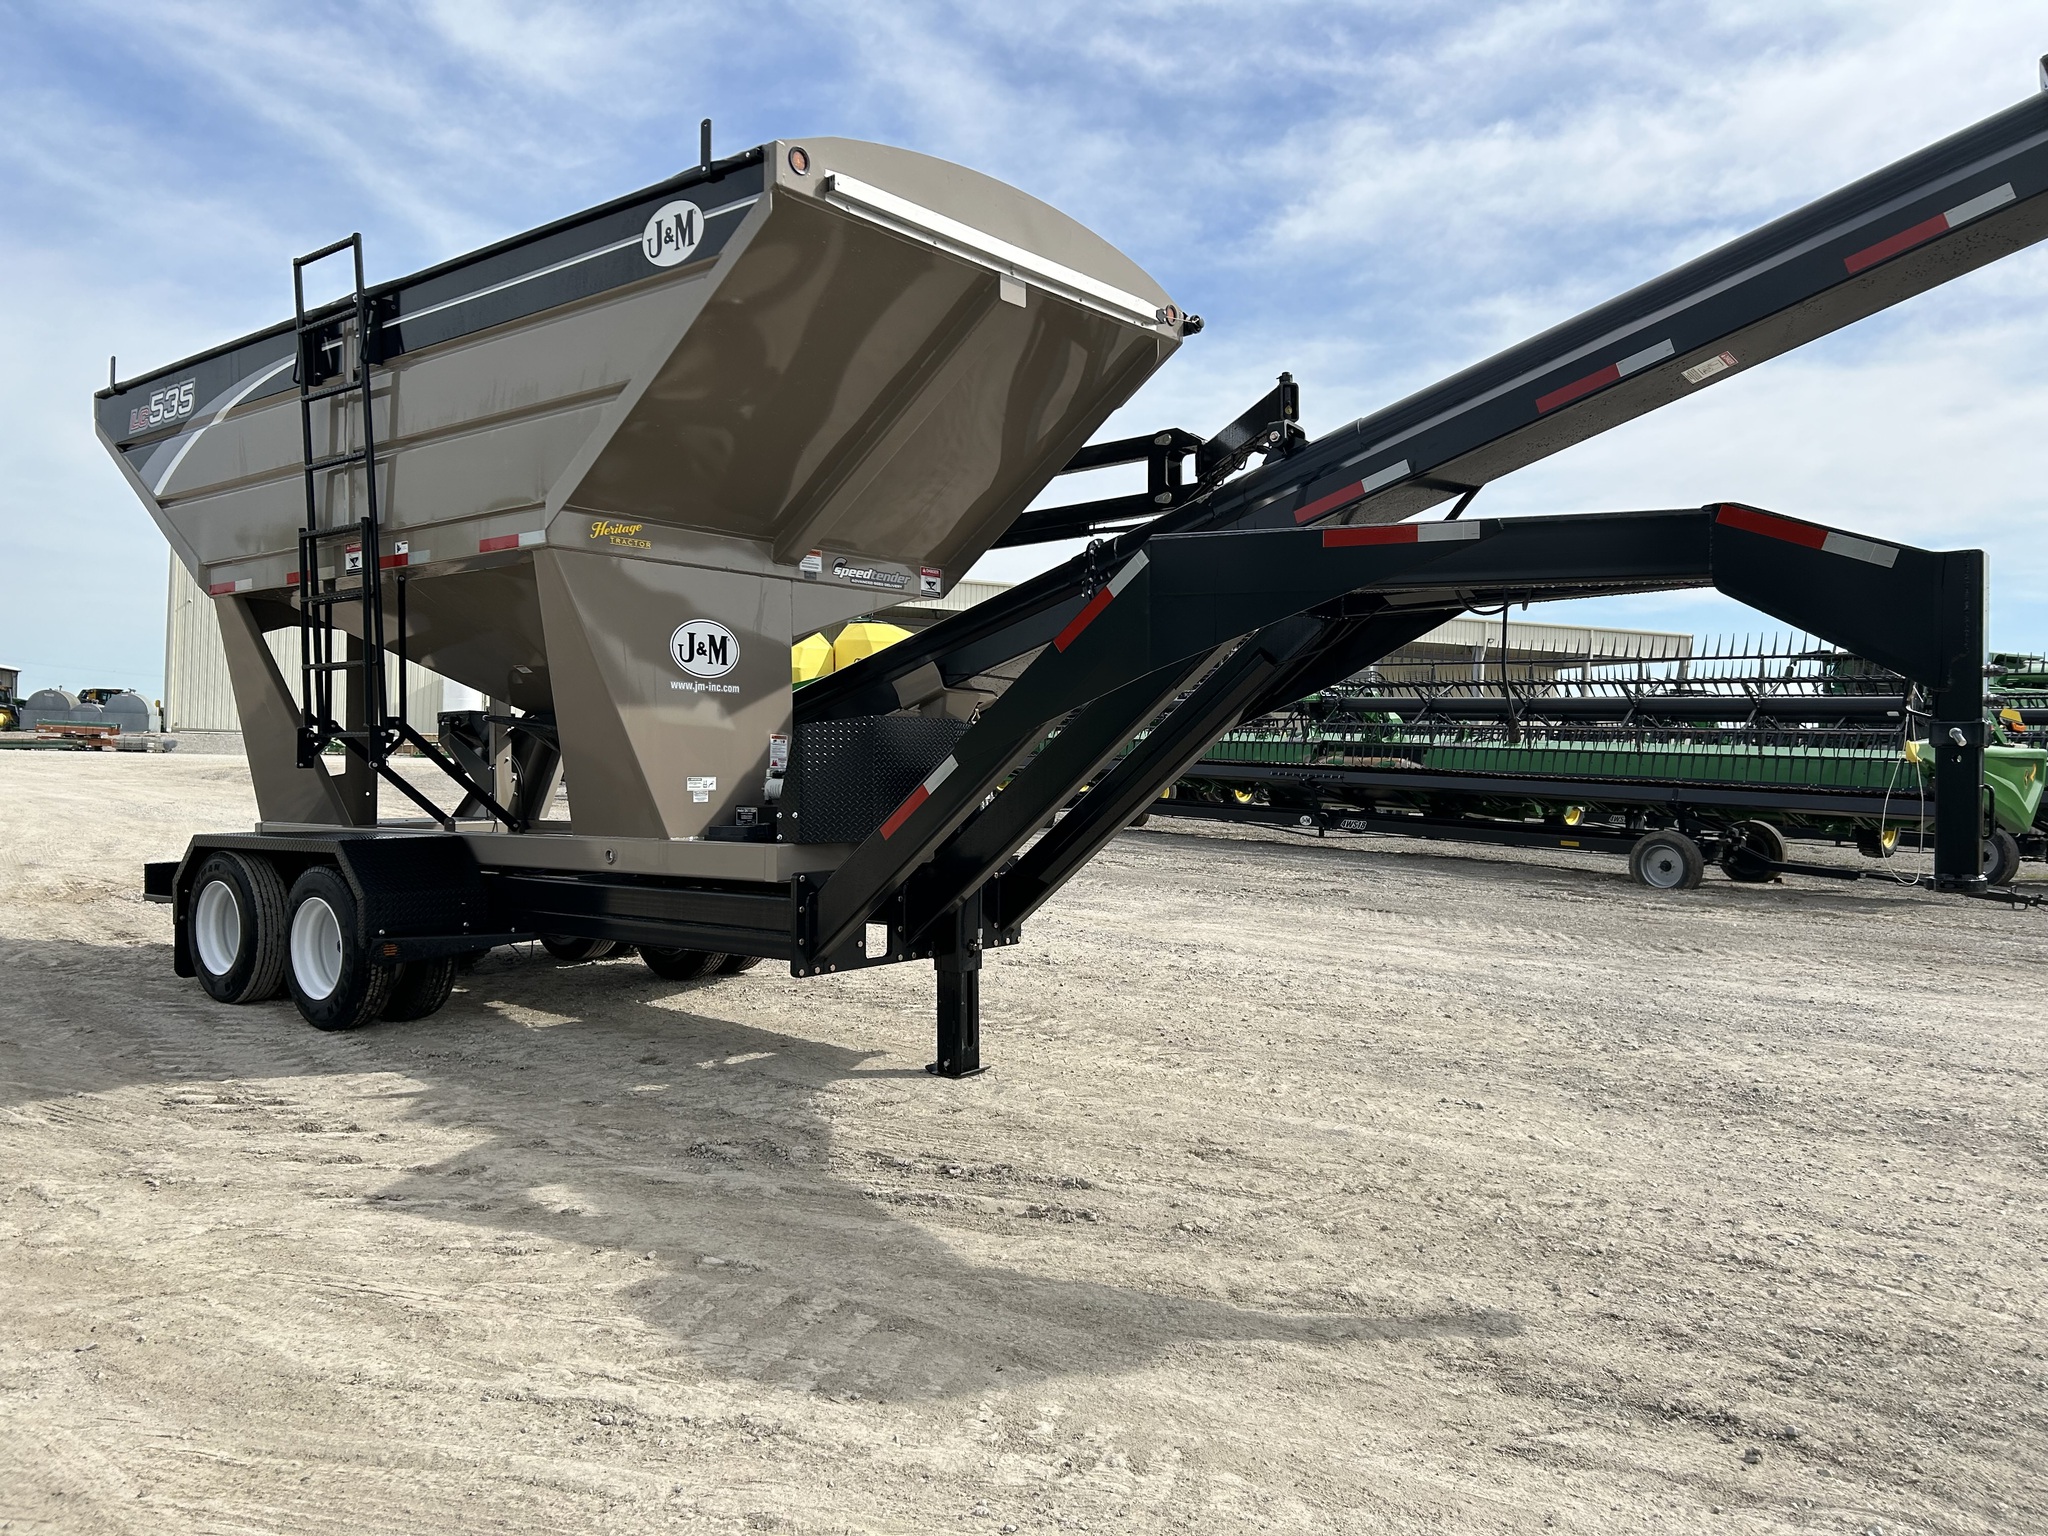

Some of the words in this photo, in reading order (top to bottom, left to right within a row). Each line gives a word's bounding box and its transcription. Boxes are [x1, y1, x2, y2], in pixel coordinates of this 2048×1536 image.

[647, 208, 695, 259] J&M
[129, 382, 195, 432] LC535
[590, 520, 643, 539] Heritage
[610, 537, 652, 549] TRACTOR
[833, 566, 911, 584] speedtender
[677, 632, 729, 666] J&M
[670, 681, 740, 694] www.jm-inc.com
